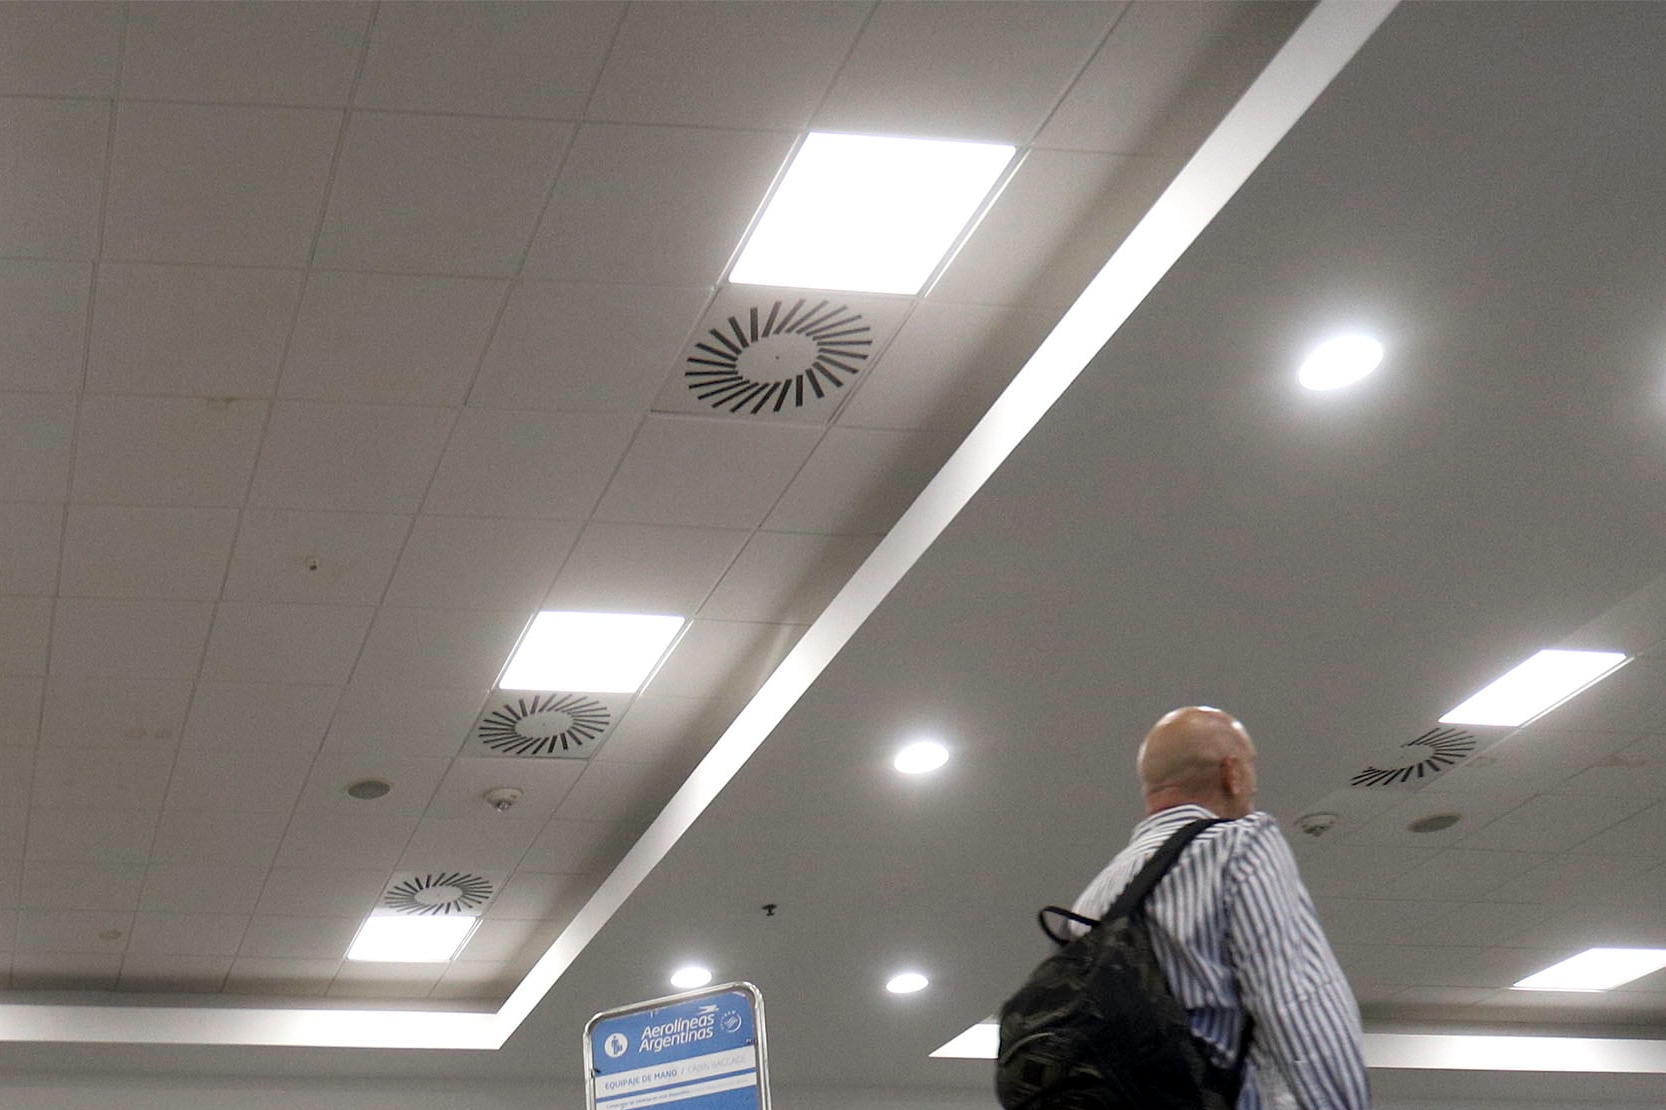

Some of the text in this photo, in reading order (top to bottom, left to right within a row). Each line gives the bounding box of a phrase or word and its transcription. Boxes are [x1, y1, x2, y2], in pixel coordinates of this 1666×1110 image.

[638, 1025, 714, 1053] Argentinas
[640, 1013, 715, 1040] Aerolíneas
[604, 1076, 640, 1091] EQUIPAJE
[641, 1074, 653, 1083] DE
[653, 1069, 678, 1081] MANO
